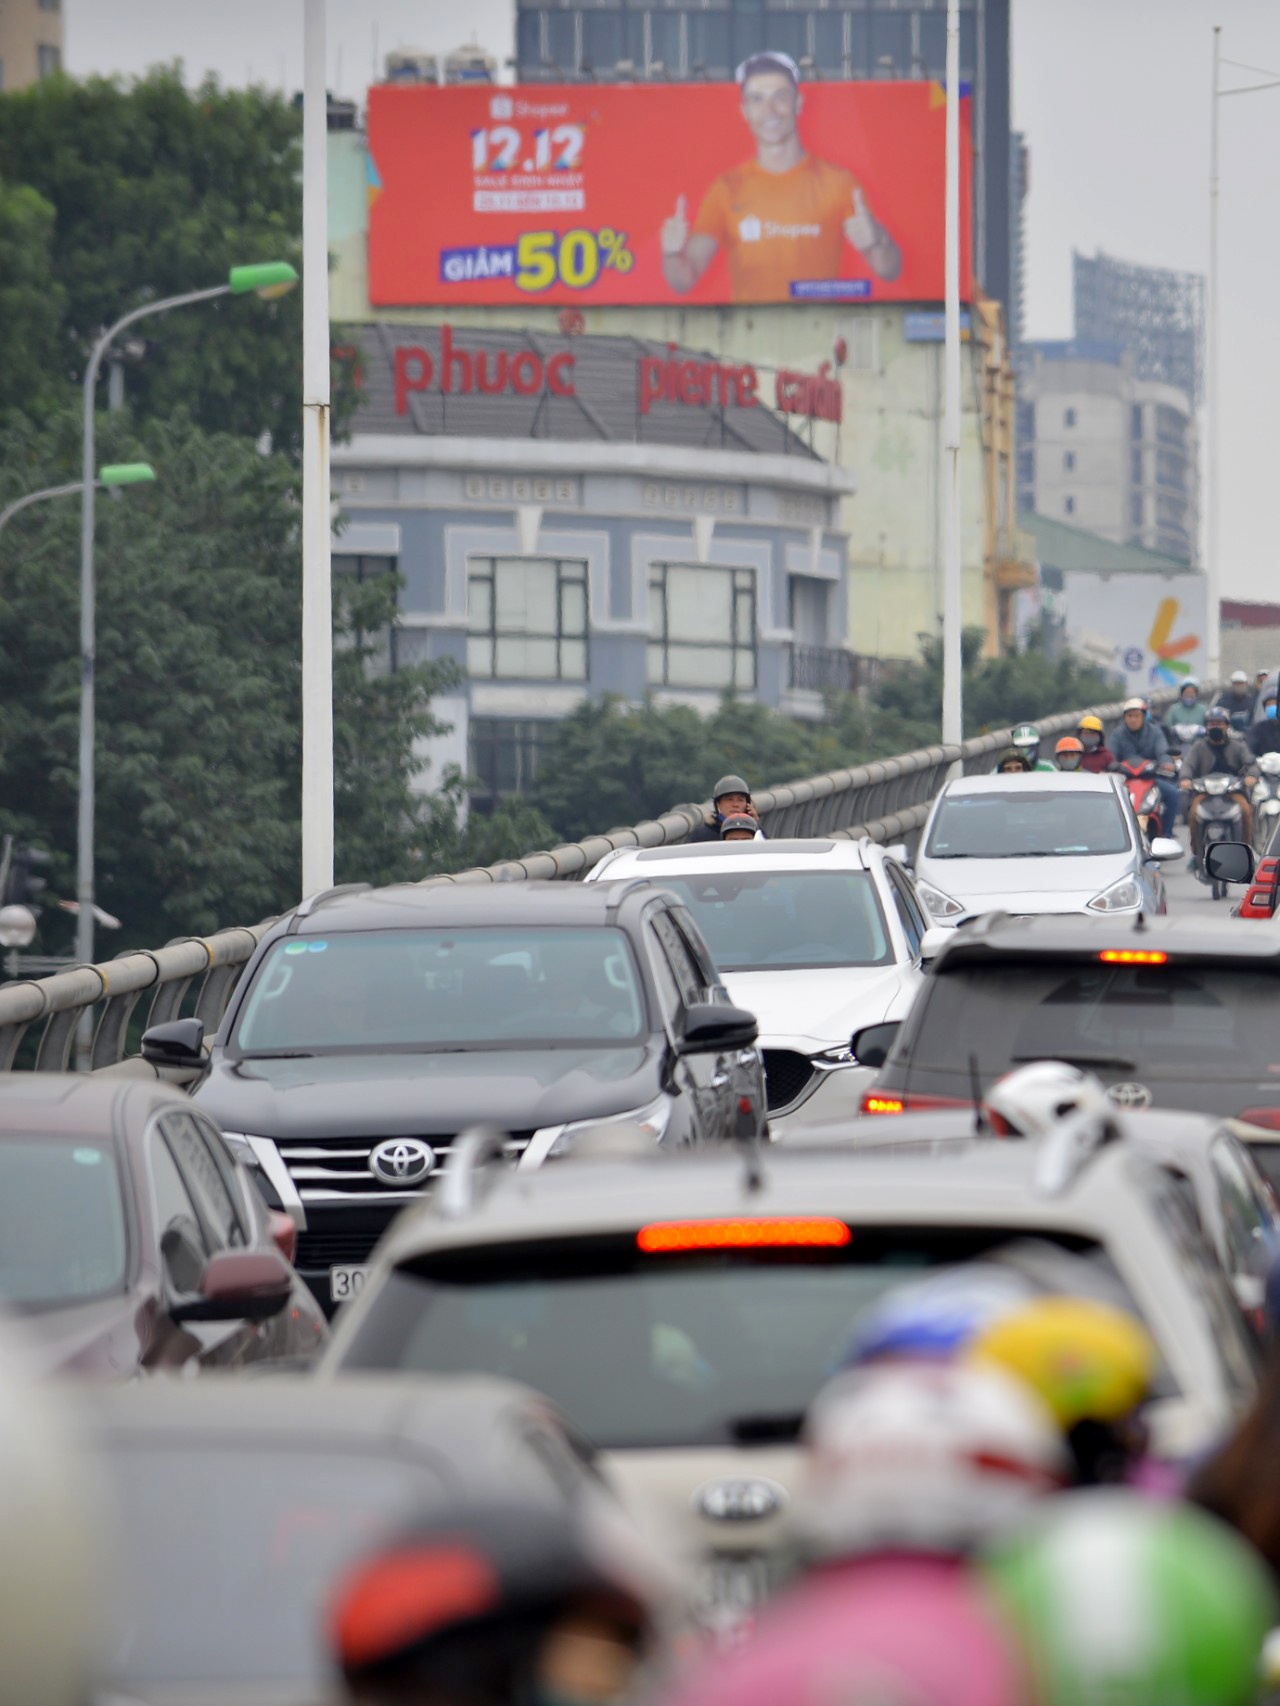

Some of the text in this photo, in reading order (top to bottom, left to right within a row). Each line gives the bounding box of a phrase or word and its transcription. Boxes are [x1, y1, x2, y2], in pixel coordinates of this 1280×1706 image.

[471, 123, 586, 173] 12.12
[443, 227, 634, 291] GIẢM 50%
[765, 222, 821, 238] Shopee
[394, 323, 577, 417] phuoc
[639, 341, 758, 416] pierre
